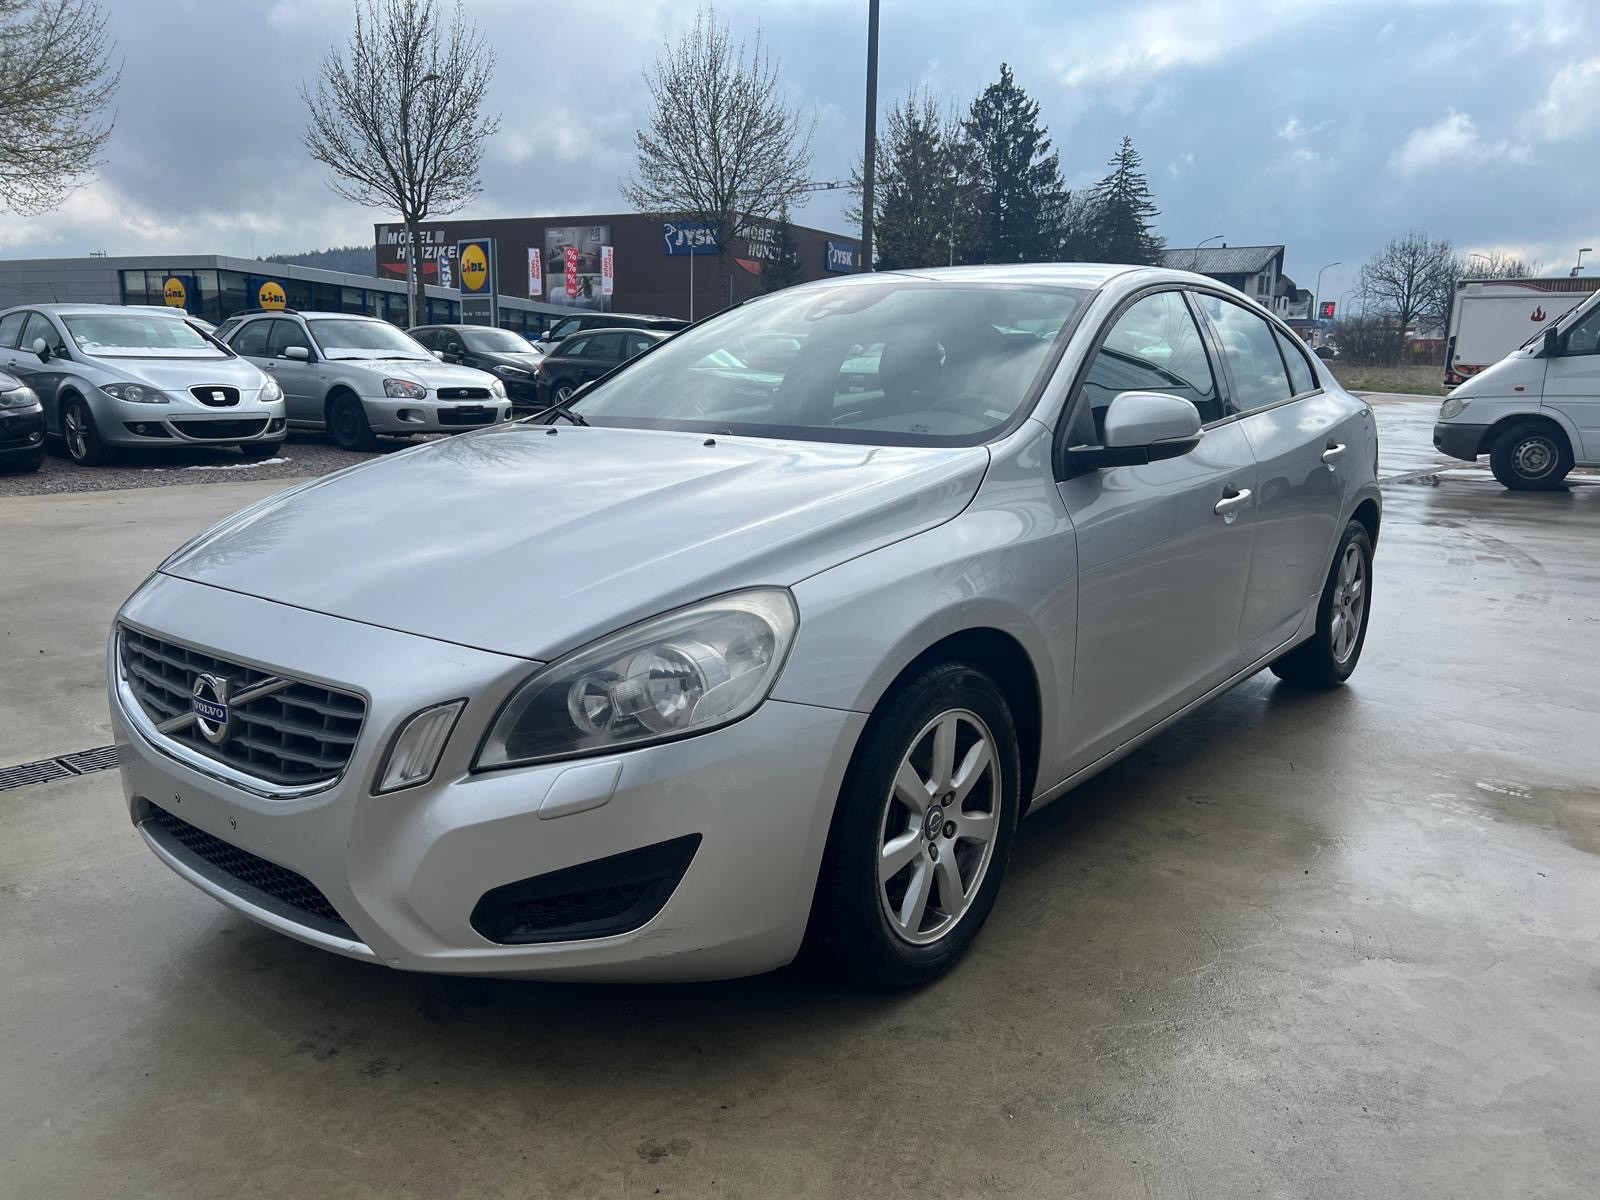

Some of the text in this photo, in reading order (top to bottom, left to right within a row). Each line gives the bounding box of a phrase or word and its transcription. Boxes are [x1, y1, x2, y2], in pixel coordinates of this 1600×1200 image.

[675, 228, 718, 246] JYSK
[832, 249, 853, 266] JYSK
[193, 701, 224, 718] VOLVO
